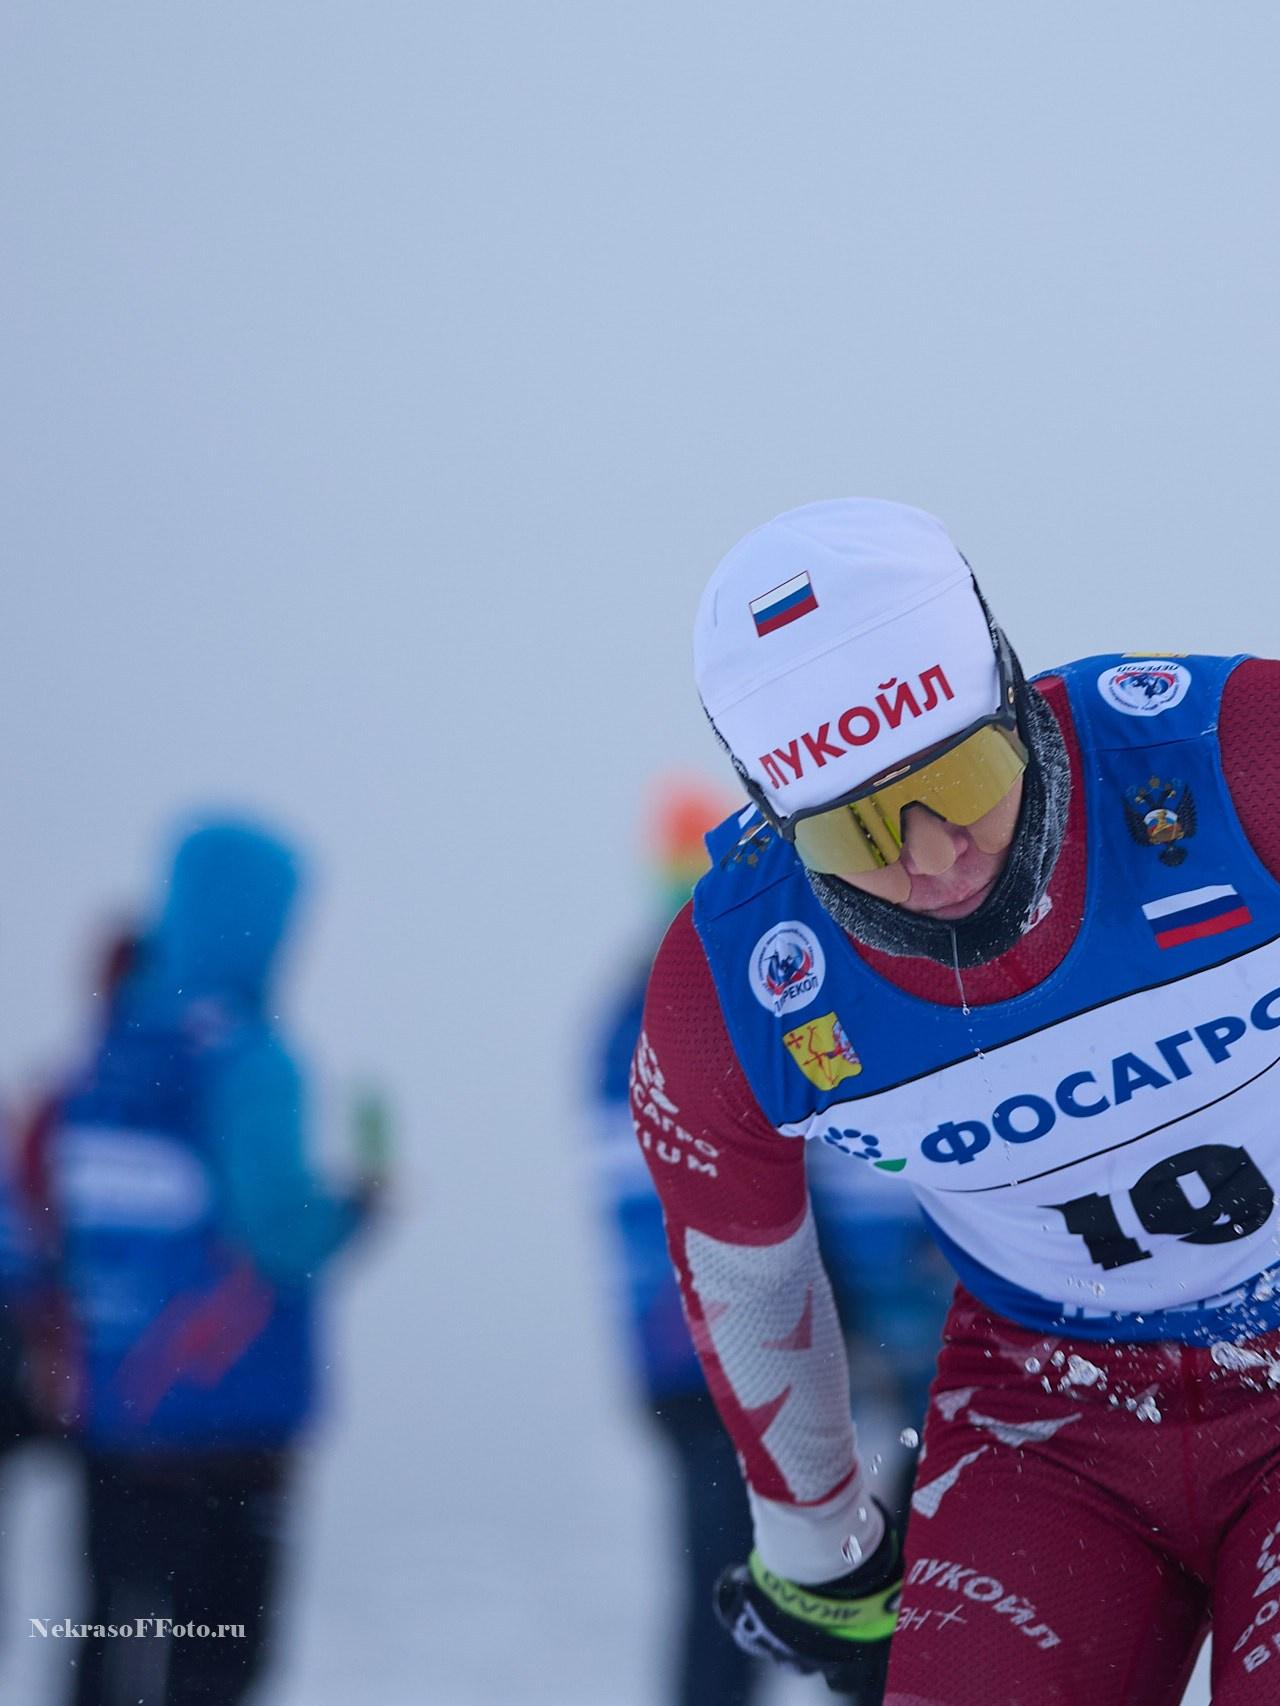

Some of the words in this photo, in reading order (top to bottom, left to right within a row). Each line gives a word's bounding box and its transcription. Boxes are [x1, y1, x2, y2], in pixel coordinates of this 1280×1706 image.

[758, 664, 955, 790] ЛУКОЙЛ
[1037, 1143, 1274, 1271] 19
[906, 1558, 1063, 1649] ЛУКОЙЛ
